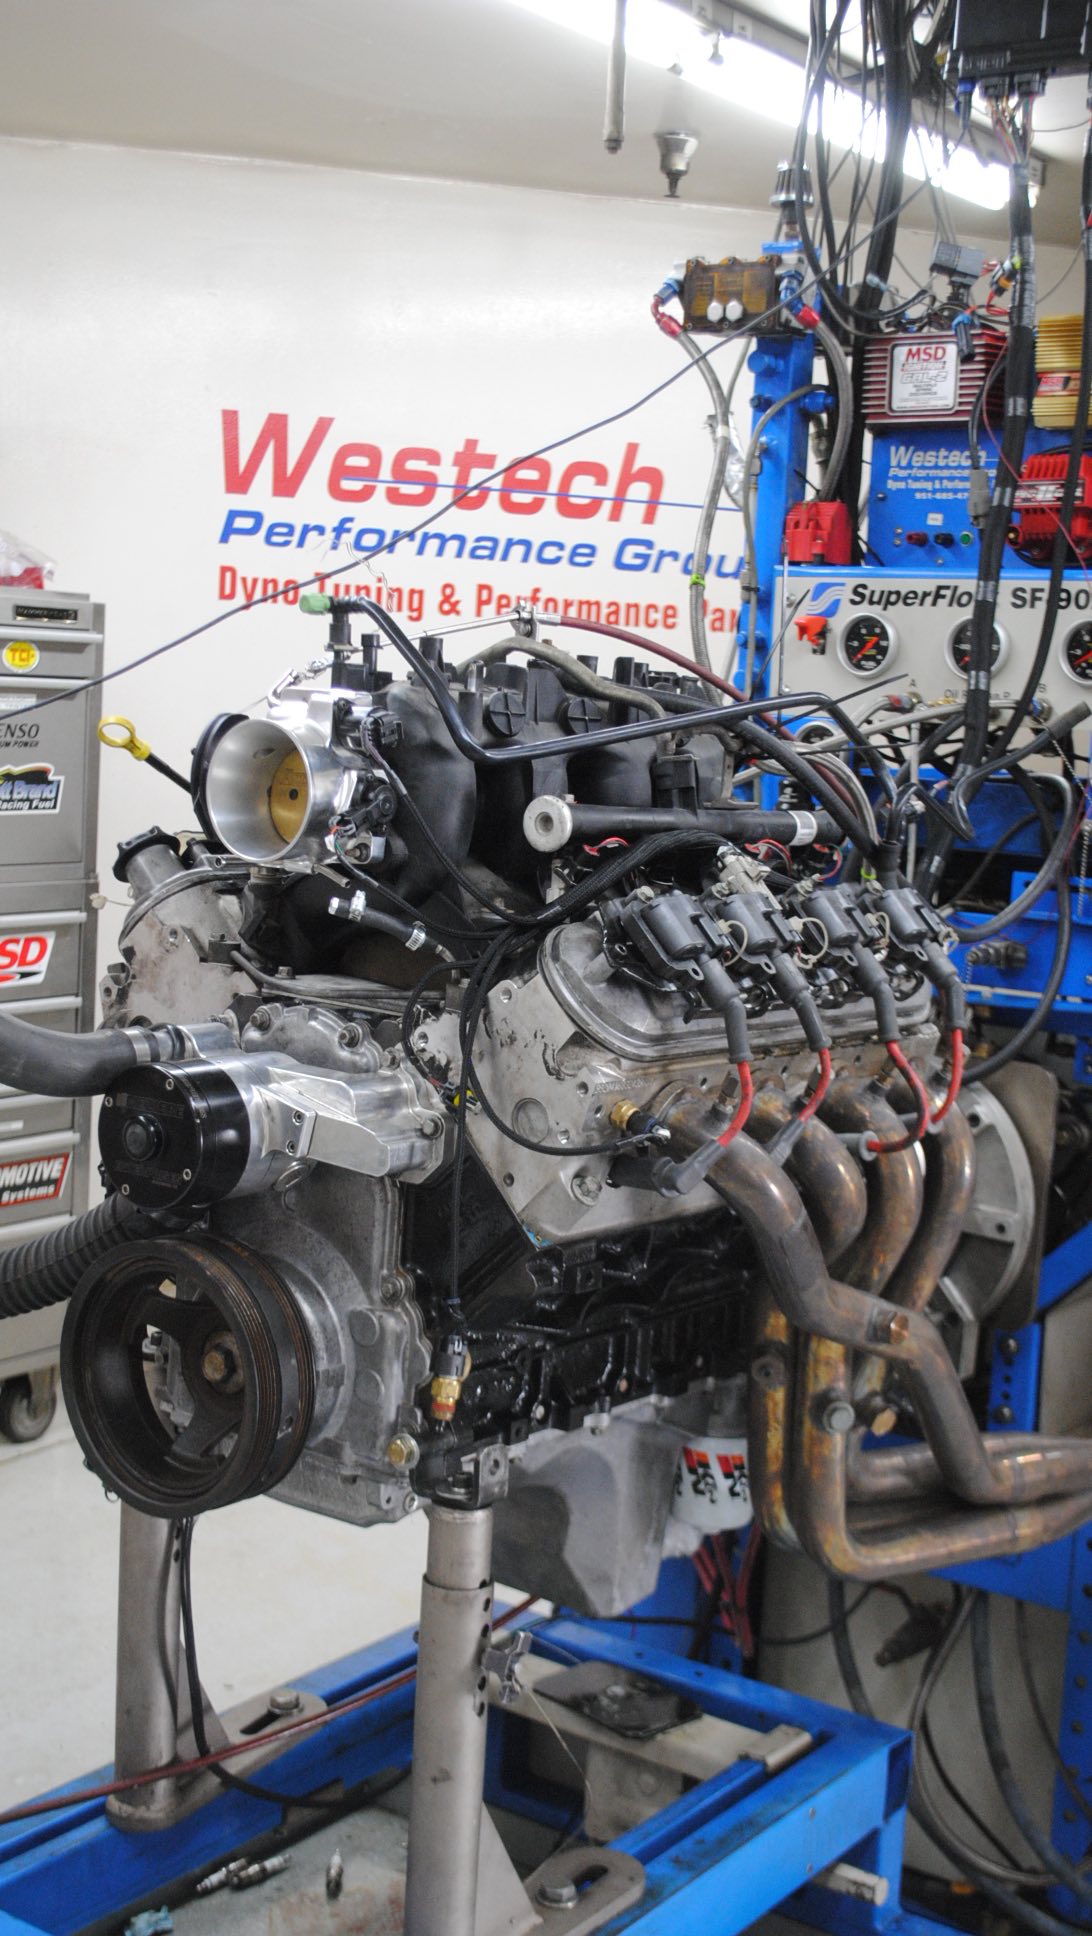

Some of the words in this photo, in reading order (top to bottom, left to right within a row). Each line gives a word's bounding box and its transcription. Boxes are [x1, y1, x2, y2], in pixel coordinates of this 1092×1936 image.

[905, 345, 946, 362] MSD
[221, 409, 664, 525] Westech
[218, 509, 597, 567] Performance
[613, 538, 746, 580] Grou
[218, 565, 300, 610] Dyno
[438, 583, 462, 616] &
[849, 583, 974, 611] SuperFlo
[1057, 588, 1092, 610] 90
[0, 723, 40, 739] ENSO
[13, 780, 58, 800] Brand
[31, 799, 55, 810] Fuel
[0, 935, 48, 970] SD
[0, 1157, 64, 1189] MOTIVE
